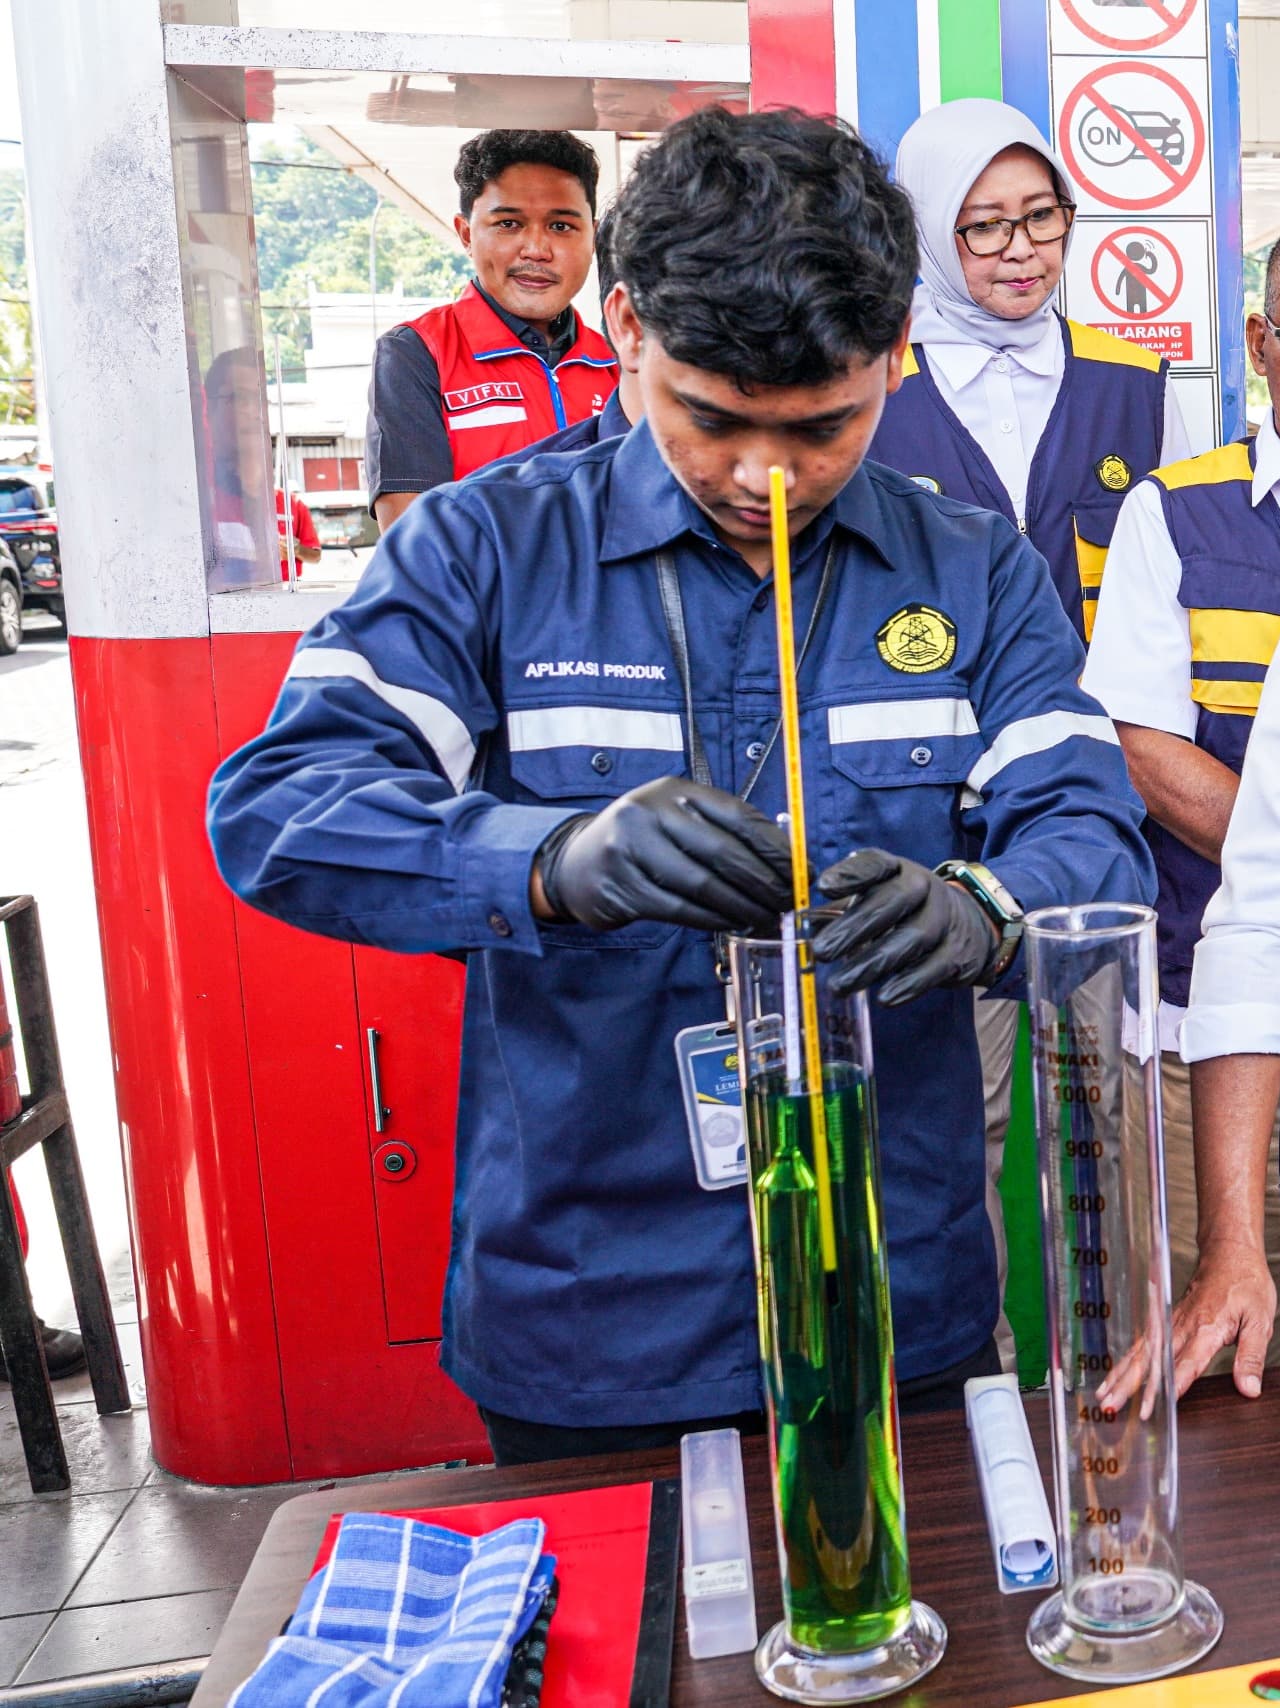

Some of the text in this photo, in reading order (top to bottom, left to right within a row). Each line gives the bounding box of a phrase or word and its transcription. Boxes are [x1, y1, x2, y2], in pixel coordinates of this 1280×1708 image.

[1086, 126, 1122, 147] ON
[457, 385, 512, 404] VIFKI
[525, 661, 666, 681] APLIKASI PRODUK
[1053, 1085, 1101, 1103] 1000
[1065, 1141, 1103, 1158] 900
[1068, 1195, 1105, 1213] 800
[1071, 1248, 1108, 1266] 700
[1074, 1302, 1110, 1320] 600
[1077, 1354, 1113, 1372] 500
[1079, 1406, 1117, 1424] 400
[1083, 1457, 1118, 1475] 300
[1085, 1507, 1121, 1525] 200
[1088, 1557, 1124, 1576] 100
